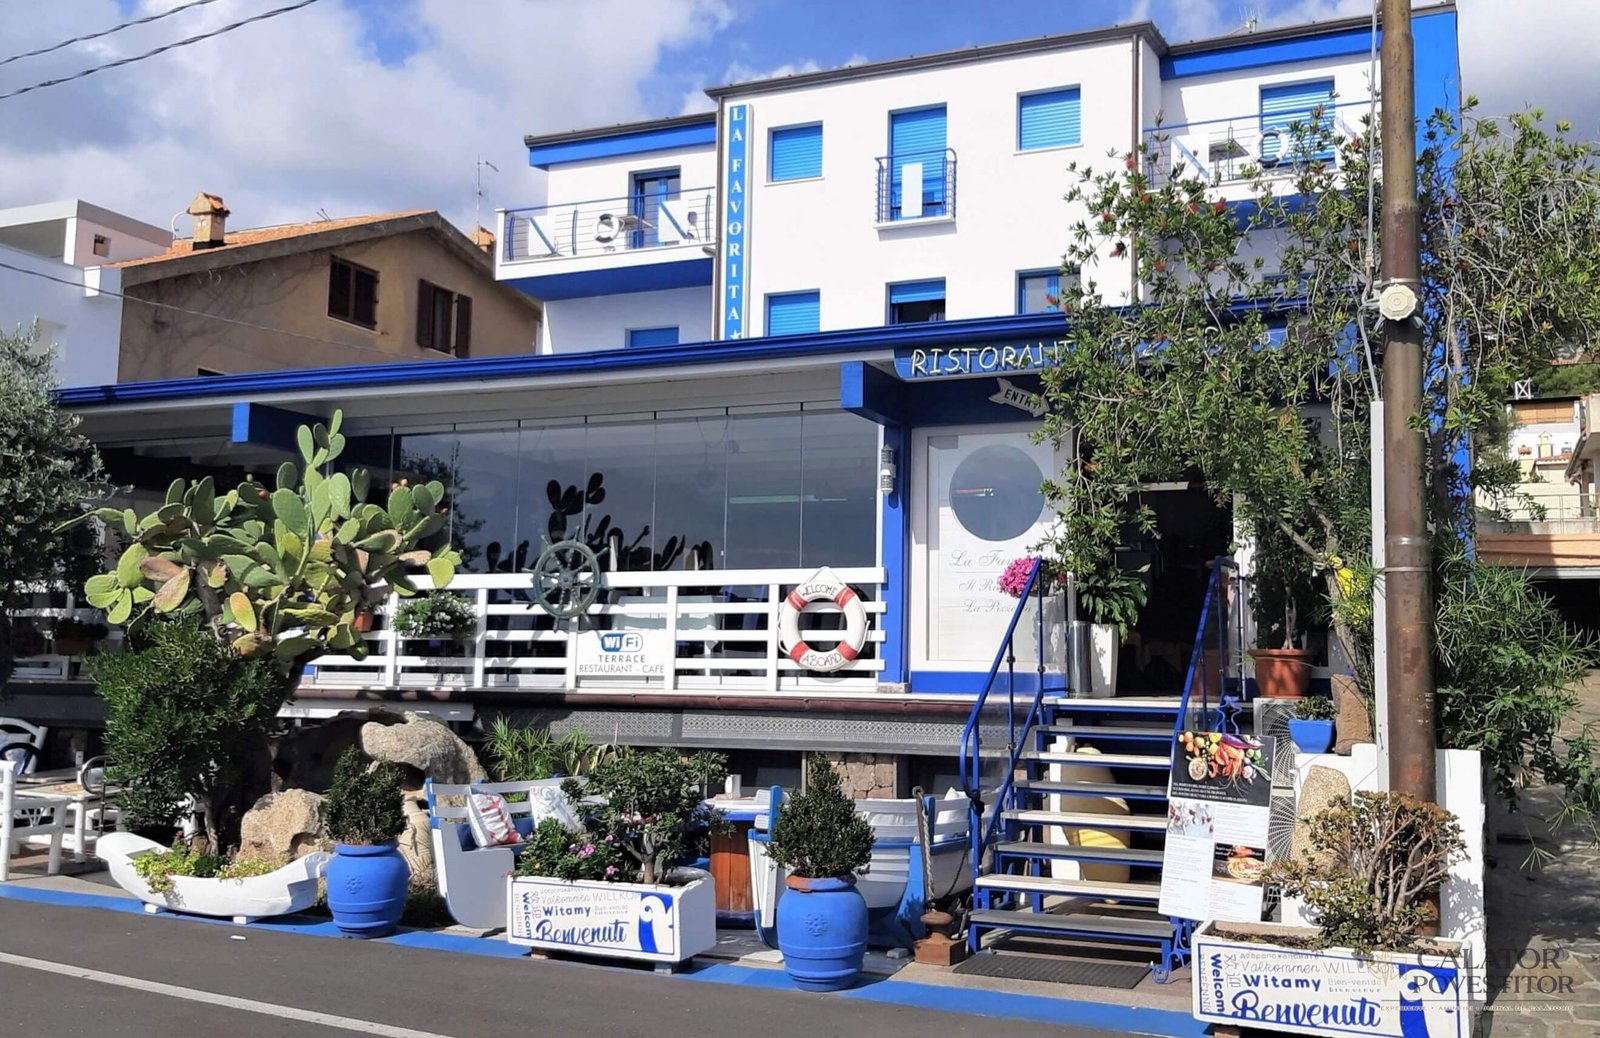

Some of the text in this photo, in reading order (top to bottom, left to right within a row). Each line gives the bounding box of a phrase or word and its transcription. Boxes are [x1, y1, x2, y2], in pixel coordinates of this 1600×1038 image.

[728, 107, 744, 320] LA FAVORITA
[911, 339, 1077, 375] RISTORANT
[1004, 388, 1038, 409] ENTR
[949, 549, 973, 567] La
[801, 583, 838, 597] WELCOME
[963, 599, 979, 613] La
[598, 654, 645, 663] TERRACE
[801, 652, 842, 667] ABOARD
[579, 664, 633, 673] RESTAURANT
[542, 906, 592, 918] Witamy
[535, 918, 630, 945] Benvenuti
[1224, 954, 1242, 988] 欢迎
[1211, 953, 1225, 1012] Welcom
[1243, 974, 1321, 992] Witamy
[1231, 989, 1382, 1027] Benvenuti
